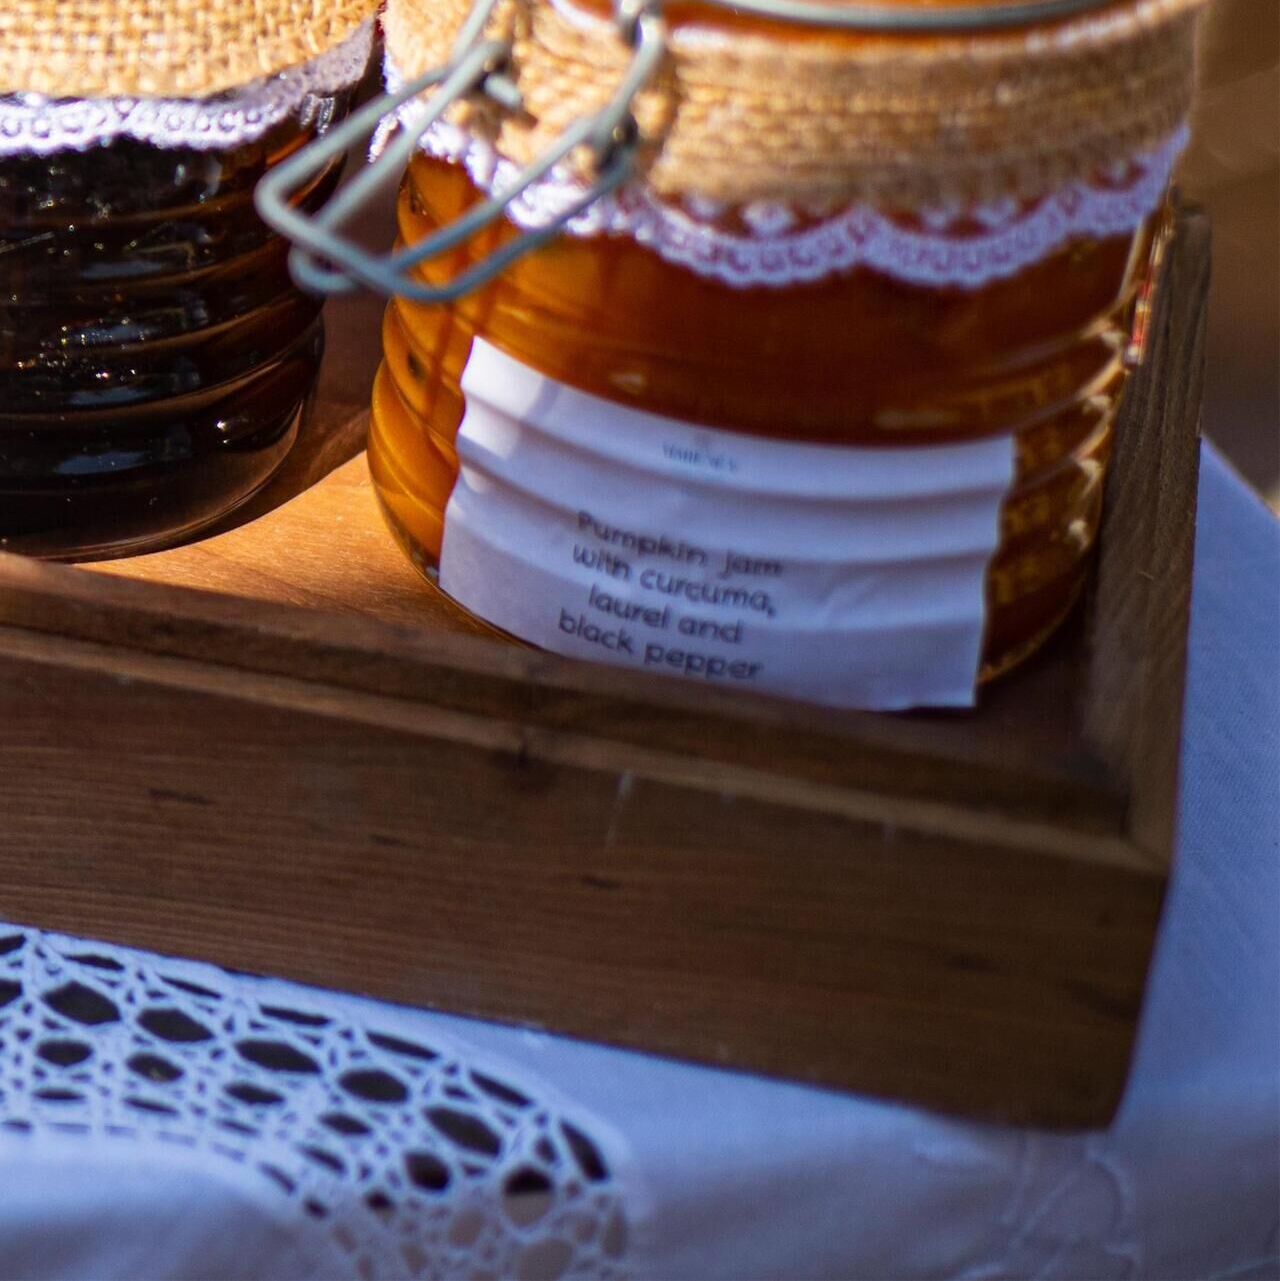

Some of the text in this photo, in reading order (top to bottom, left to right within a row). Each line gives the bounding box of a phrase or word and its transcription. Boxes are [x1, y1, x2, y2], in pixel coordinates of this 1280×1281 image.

[576, 509, 783, 580] Pumpkin jam
[571, 543, 776, 619] with curcuma,
[587, 585, 743, 644] laurel and
[558, 608, 764, 680] black pepper
